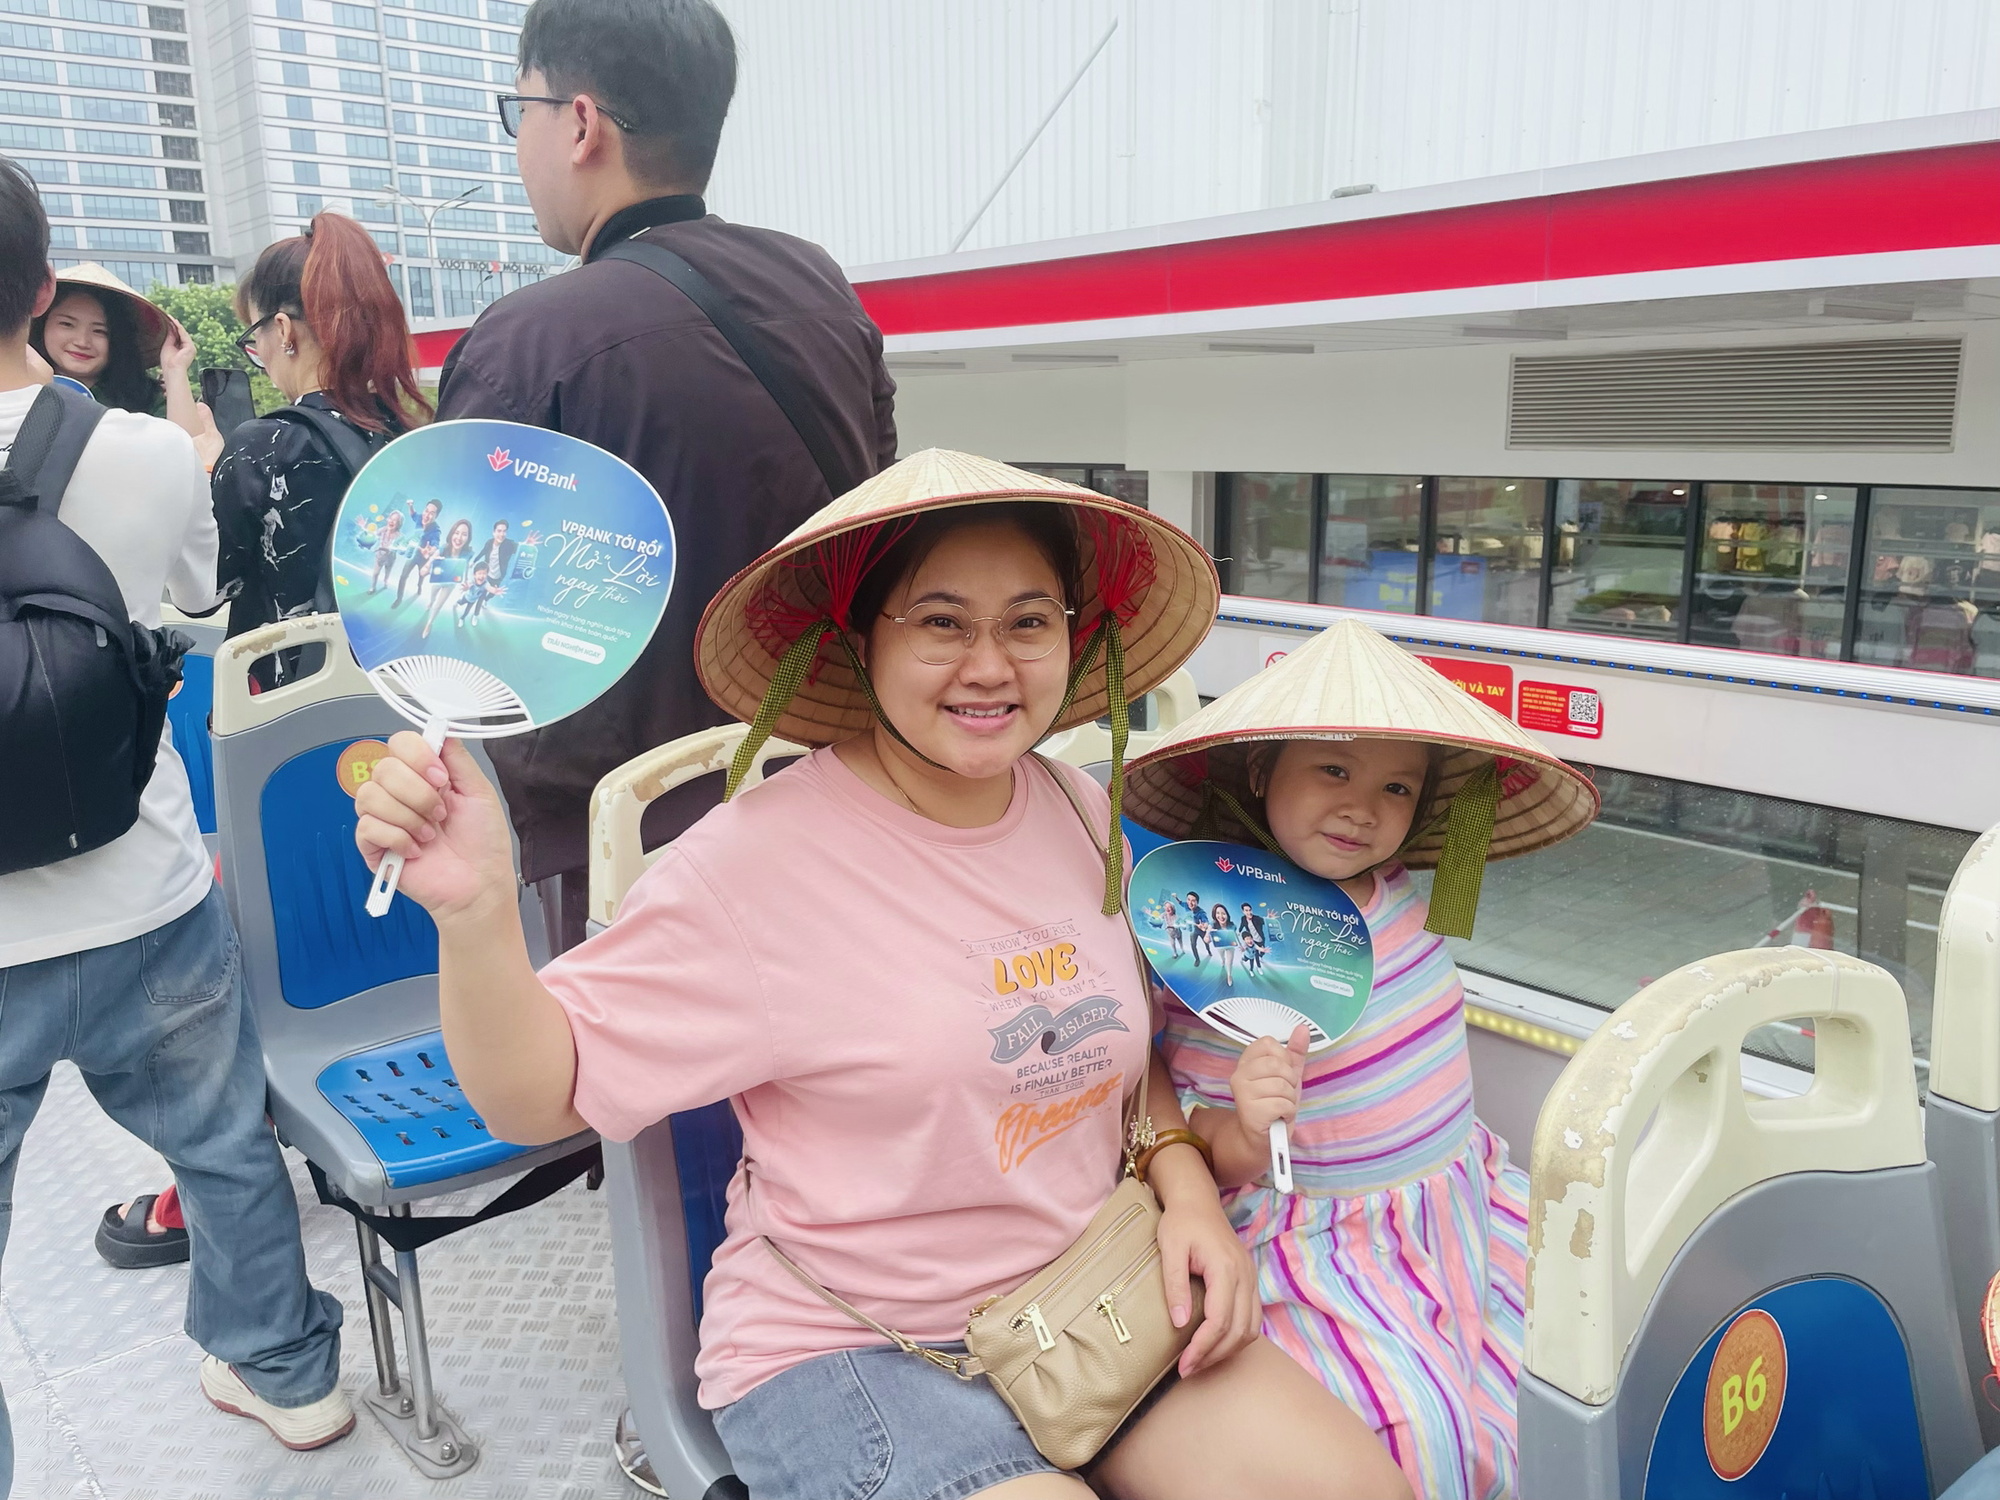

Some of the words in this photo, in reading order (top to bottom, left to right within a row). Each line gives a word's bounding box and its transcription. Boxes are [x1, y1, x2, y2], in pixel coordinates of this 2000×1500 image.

[514, 457, 579, 492] VPBank
[562, 519, 613, 545] VPBANK
[614, 534, 637, 551] TỚI
[636, 539, 662, 558] RỒI
[553, 574, 600, 609] ngay
[1468, 681, 1485, 694] VÀ
[1486, 685, 1506, 697] TAY
[352, 759, 381, 783] B
[1236, 863, 1287, 884] VPBank
[1286, 901, 1325, 917] VPBANK
[989, 937, 1021, 953] KNOW
[993, 942, 1079, 995] LOVE
[989, 996, 1022, 1012] WHEN
[1031, 989, 1055, 1003] YOU
[1059, 978, 1098, 997] CAN'T
[1006, 1015, 1044, 1050] FALL
[1058, 1006, 1108, 1042] ASLEEP
[1010, 1084, 1021, 1094] IS
[1024, 1070, 1069, 1091] FINALLY
[1070, 1058, 1113, 1078] BETTER
[1016, 1056, 1065, 1079] BECAUSE
[1066, 1045, 1109, 1065] REALITY
[1039, 1087, 1060, 1097] THAN
[1065, 1080, 1085, 1090] YOUR
[1721, 1355, 1768, 1437] B6
